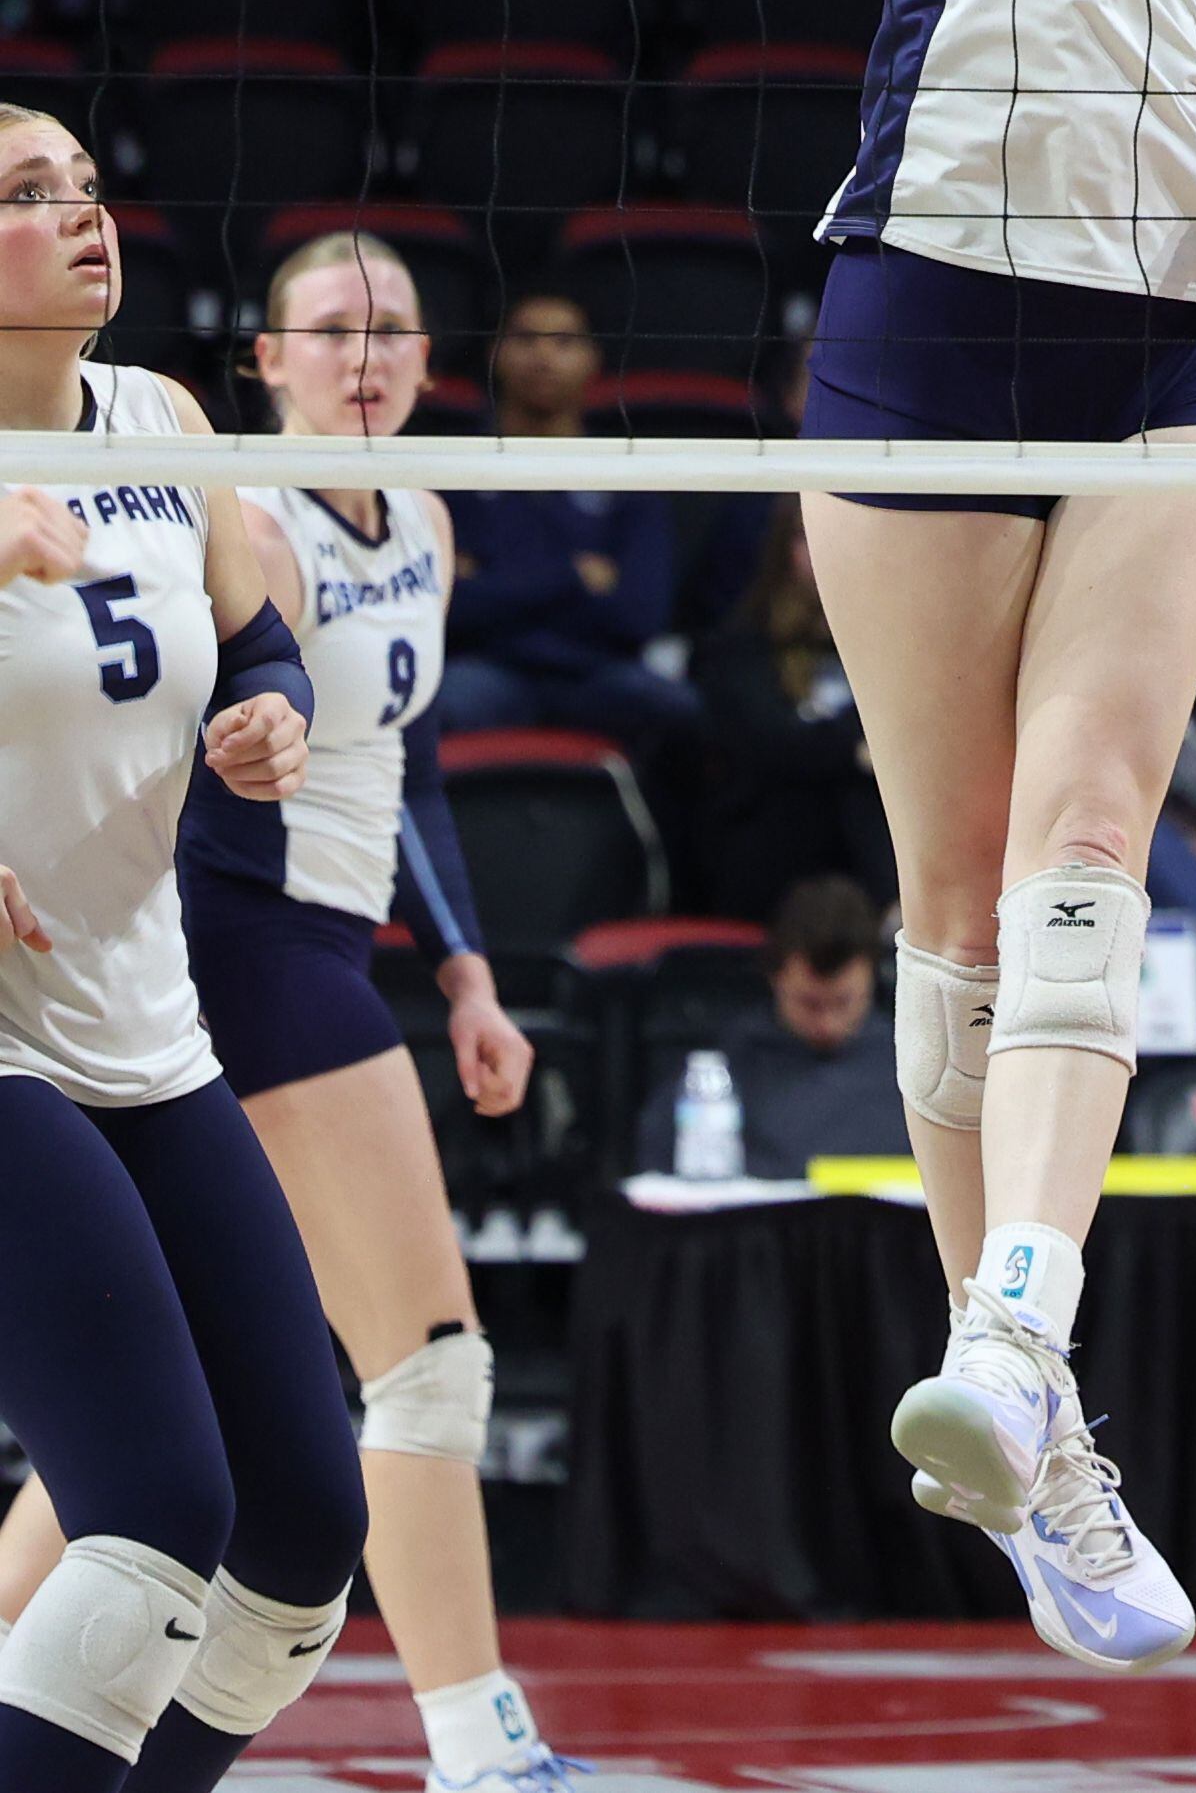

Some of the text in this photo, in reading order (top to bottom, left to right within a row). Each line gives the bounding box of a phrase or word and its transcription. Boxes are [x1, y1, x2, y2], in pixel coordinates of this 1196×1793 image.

[93, 485, 194, 528] PARK
[75, 572, 162, 705] 5
[378, 638, 416, 727] 9
